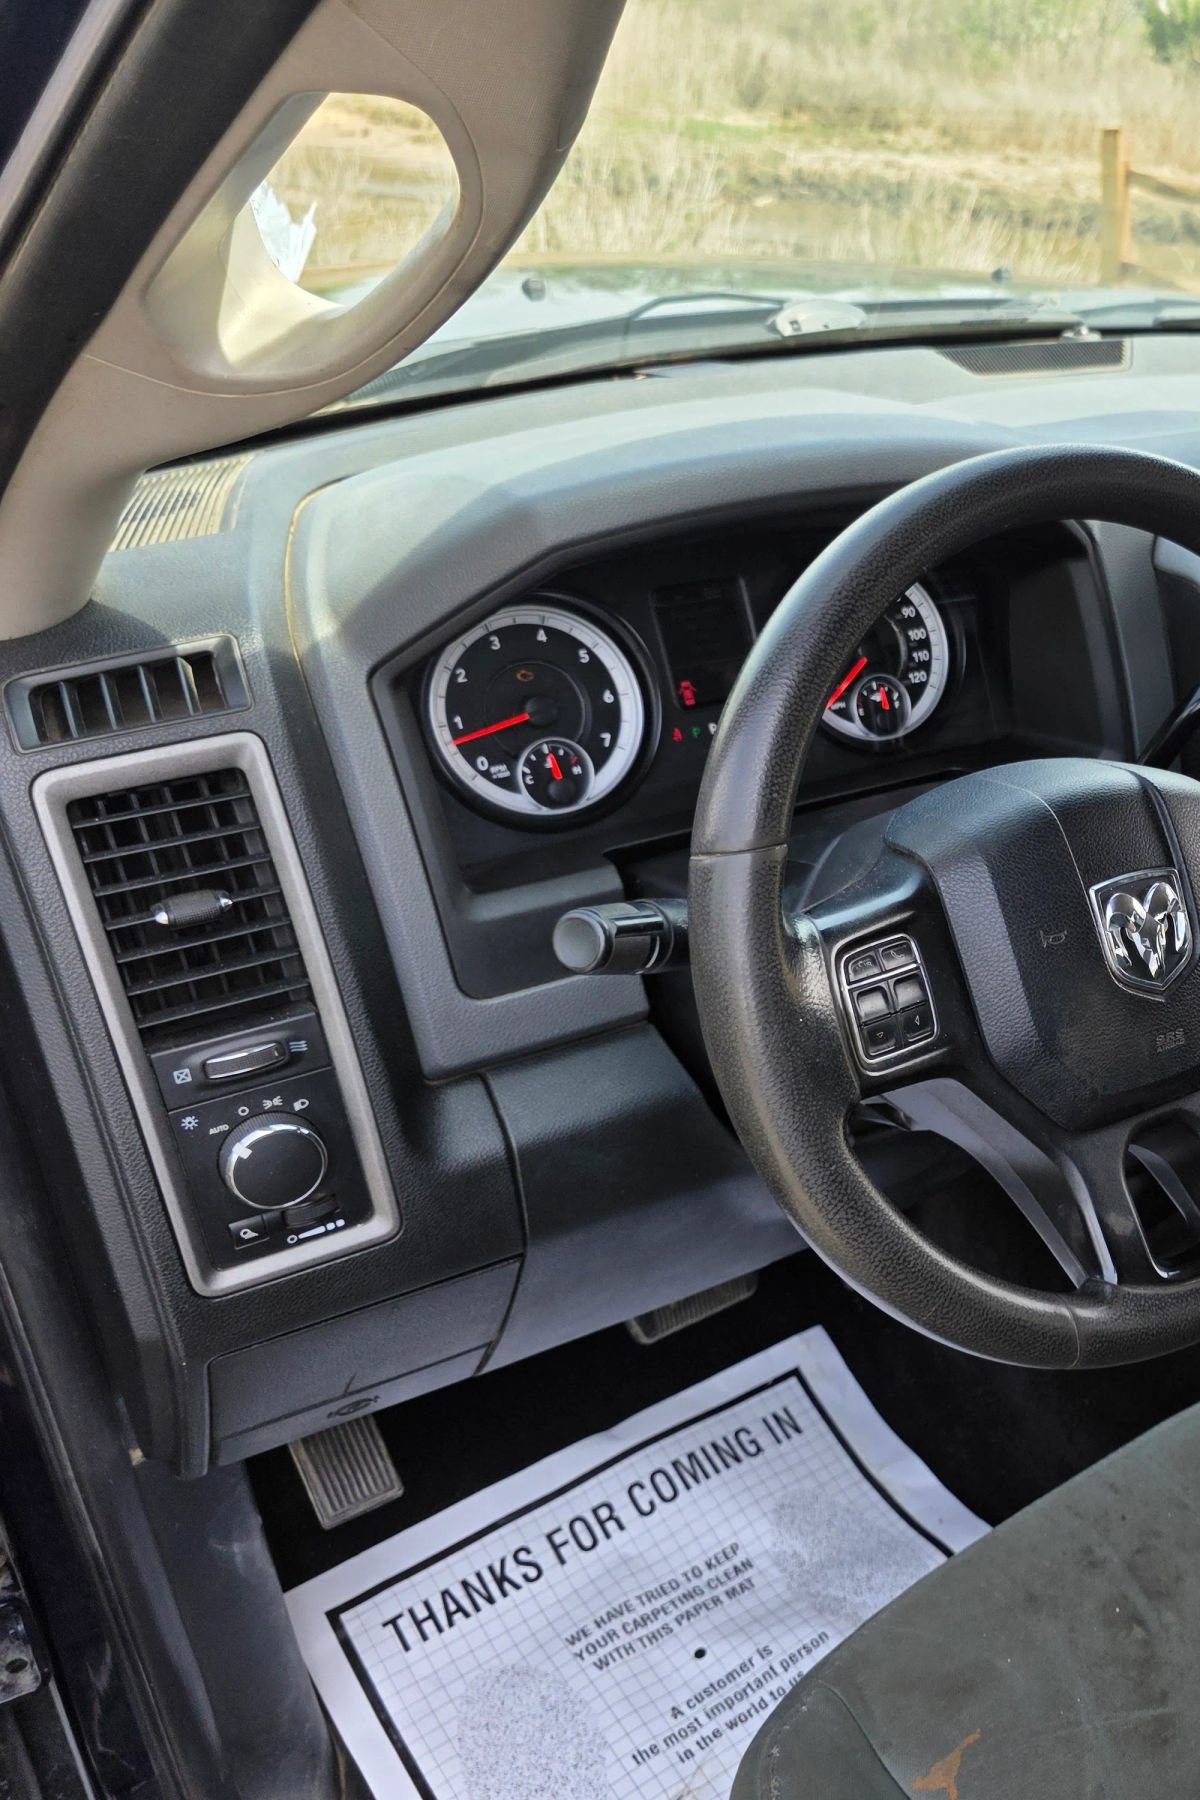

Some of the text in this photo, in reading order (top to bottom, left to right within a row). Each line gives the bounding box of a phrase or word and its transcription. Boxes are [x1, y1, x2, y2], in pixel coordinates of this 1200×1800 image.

[901, 607, 916, 618] 90
[536, 629, 548, 643] 4
[908, 628, 927, 640] 100
[489, 636, 501, 650] 3
[578, 649, 590, 663] 5
[912, 650, 930, 662] 110
[455, 668, 468, 683] 2
[908, 671, 927, 683] 120
[602, 689, 614, 703] 6
[453, 715, 464, 730] 1
[600, 733, 612, 747] 7
[476, 756, 489, 771] 0
[209, 1124, 229, 1135] AUTO
[382, 1406, 802, 1653] THANKS FOR COMING IN
[565, 1542, 739, 1647] WE HAVE TRIED TO KEEP
[573, 1559, 753, 1662] YOUR CARPETING CLEAN
[593, 1578, 757, 1671] WITH THIS PAPER MAT
[670, 1644, 773, 1720] A customer is
[631, 1631, 830, 1766] the most important person
[677, 1748, 695, 1764] in
[696, 1727, 723, 1751] the
[725, 1698, 769, 1731] world
[770, 1684, 787, 1702] to
